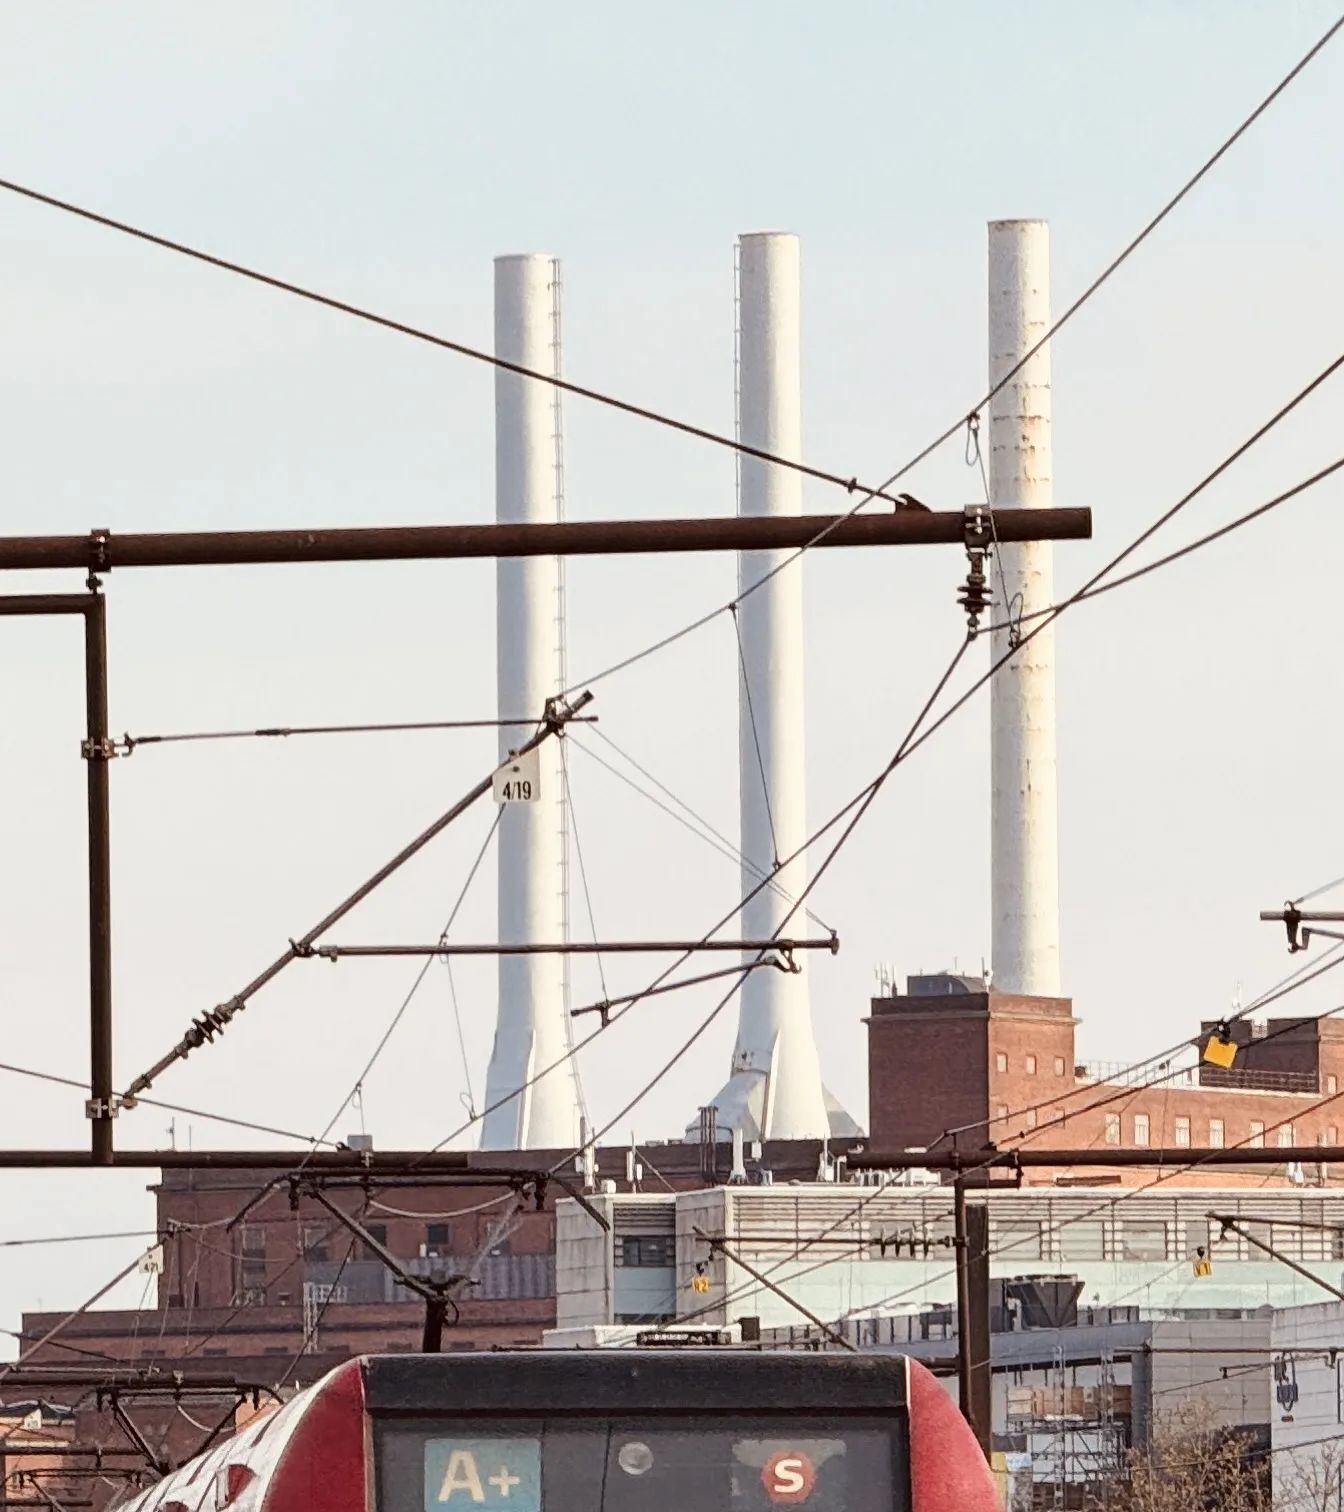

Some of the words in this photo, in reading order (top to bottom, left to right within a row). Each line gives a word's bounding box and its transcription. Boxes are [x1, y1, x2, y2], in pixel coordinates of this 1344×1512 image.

[502, 781, 531, 801] 4/19
[438, 1449, 521, 1503] A+
[772, 1459, 806, 1494] S
